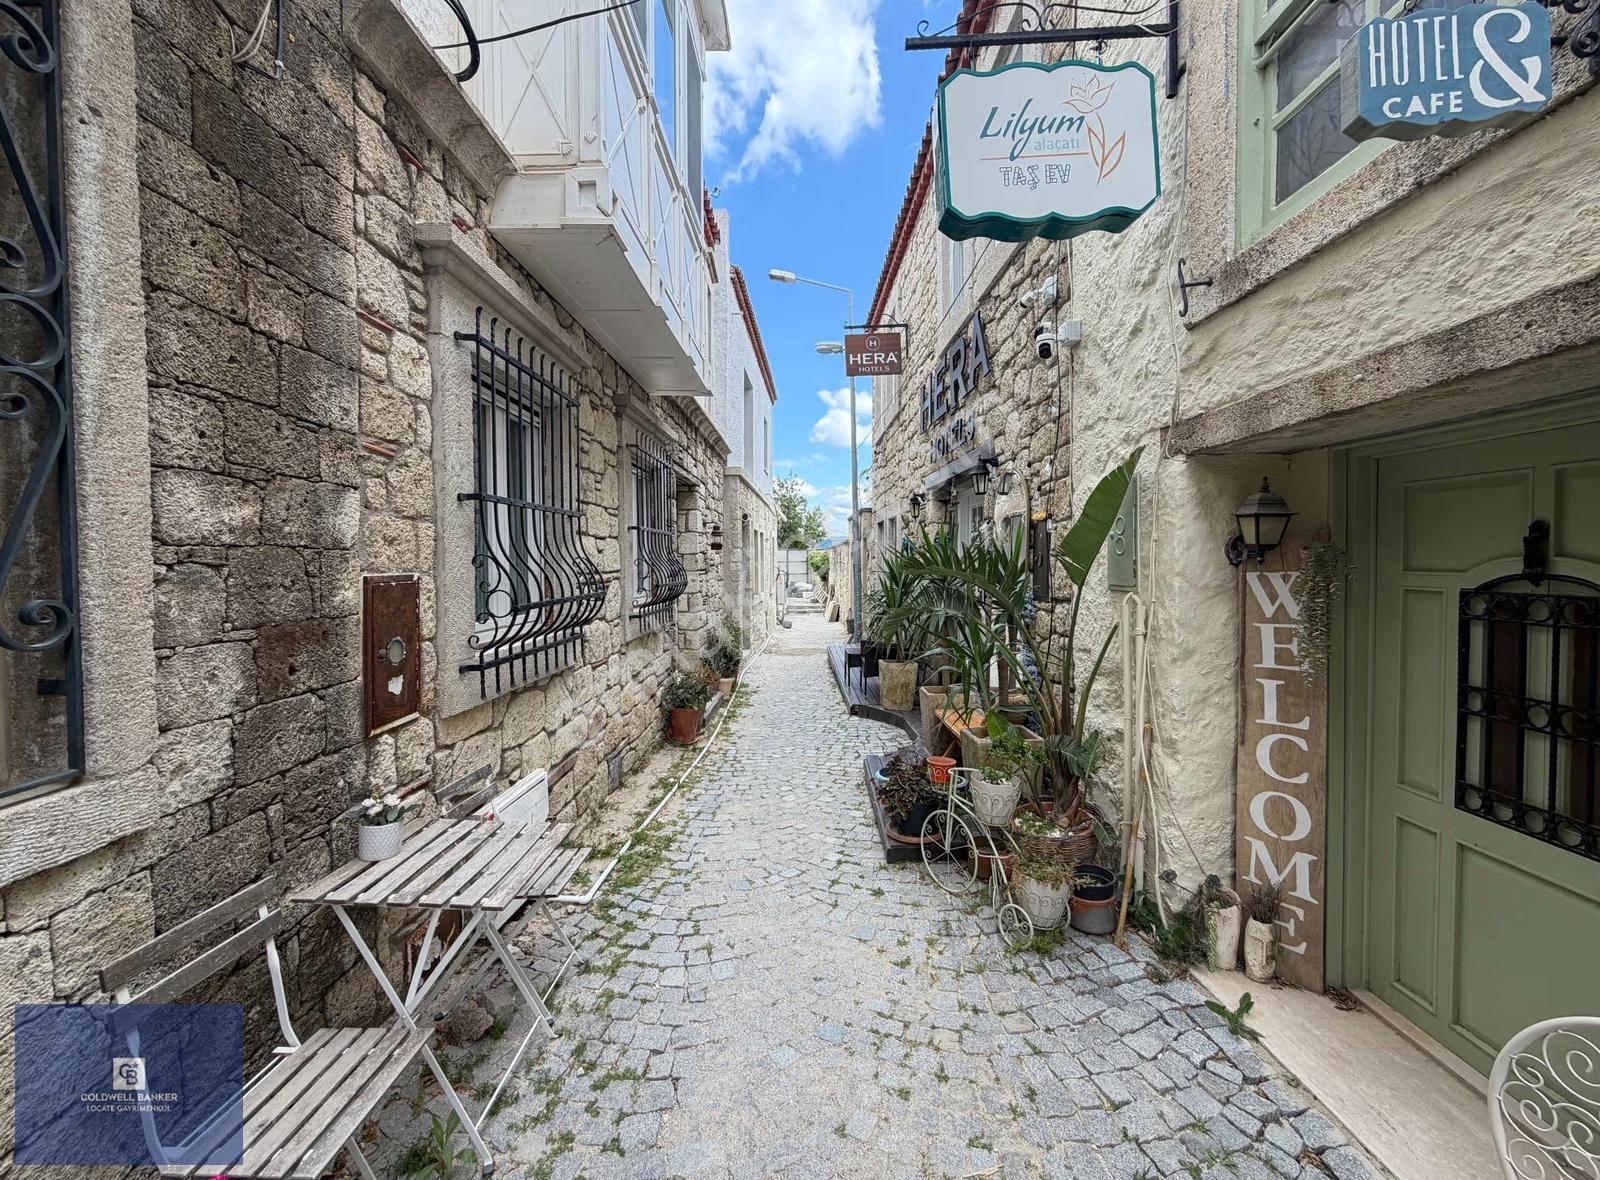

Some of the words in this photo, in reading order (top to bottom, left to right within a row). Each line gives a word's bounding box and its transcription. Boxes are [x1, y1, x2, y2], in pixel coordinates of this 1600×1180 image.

[1368, 15, 1465, 88] HOTEL
[1382, 90, 1463, 119] CAFE
[979, 98, 1086, 162] Lilyum
[1034, 136, 1080, 152] alaçatı
[999, 164, 1040, 191] TAŞ
[1045, 163, 1072, 185] EV
[849, 352, 898, 365] HERA
[858, 365, 890, 373] HOTELS
[919, 309, 992, 435] HERA
[1242, 571, 1319, 956] WELCOME
